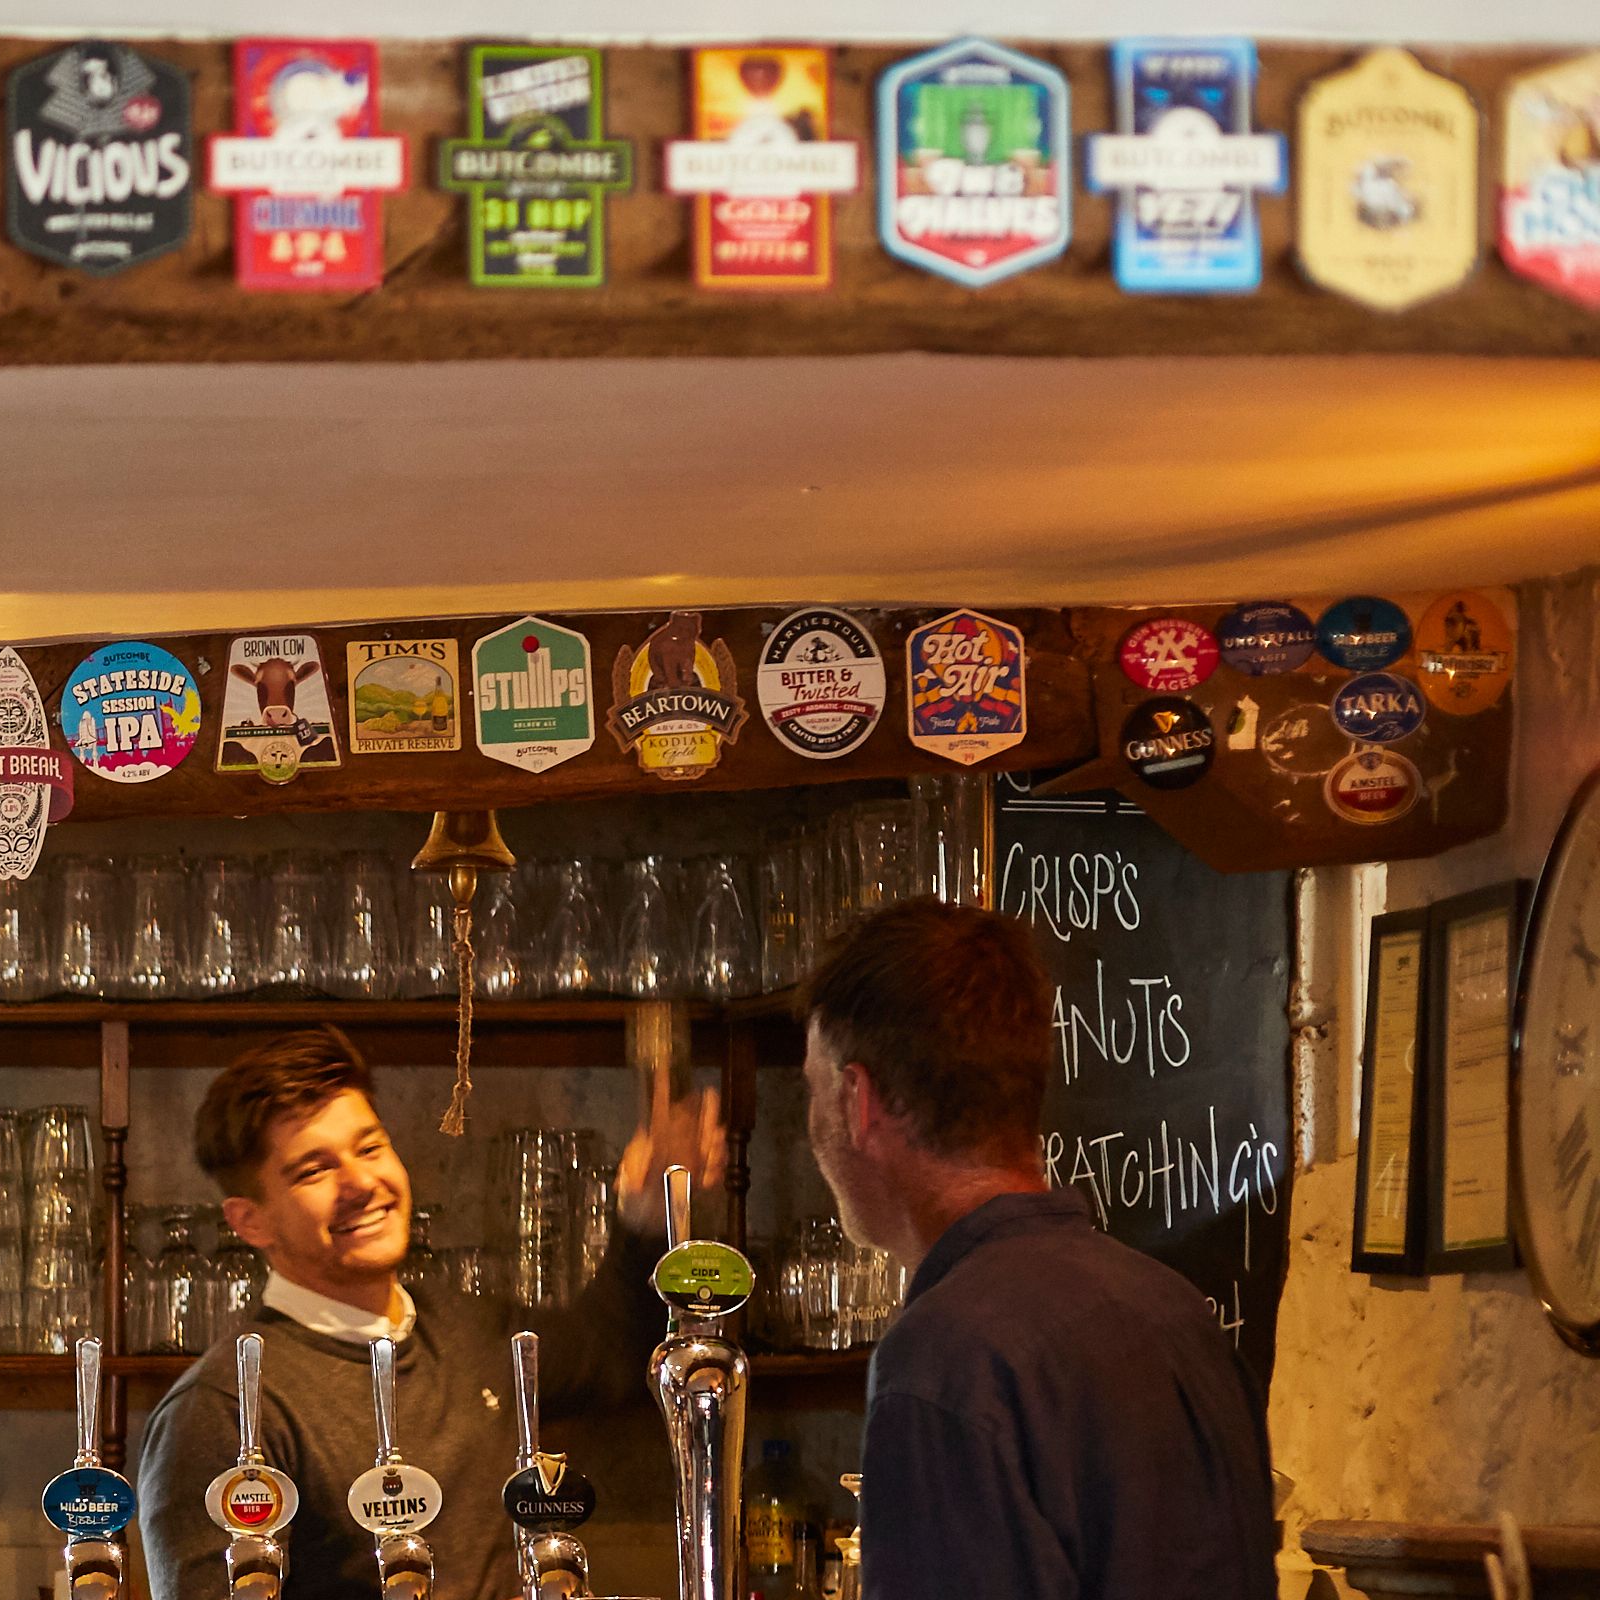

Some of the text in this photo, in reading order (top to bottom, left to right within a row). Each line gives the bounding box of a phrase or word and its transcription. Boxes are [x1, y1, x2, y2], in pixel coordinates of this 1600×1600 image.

[13, 128, 190, 206] VICIOUS
[243, 638, 305, 657] BROWN COW
[772, 617, 868, 661] HARVIESTOUN
[923, 630, 991, 664] Hot
[102, 653, 151, 666] BUTCOMBE
[359, 641, 447, 662] TIM'S
[1252, 653, 1288, 663] LAGER
[71, 670, 187, 705] STATESIDE
[480, 647, 586, 710] STUMPS
[780, 669, 853, 687] BITTER &
[939, 663, 1010, 699] Air
[1146, 674, 1200, 691] LAGER
[788, 682, 860, 701] Twisted
[102, 695, 155, 714] SESSION
[621, 694, 731, 729] BEARTOWN
[1343, 694, 1420, 713] TARKA
[104, 716, 164, 752] IPA
[647, 734, 709, 749] KODIAK
[357, 737, 455, 751] PRIVATE RESERVE
[516, 746, 559, 757] BUTCOMBE
[1126, 729, 1212, 761] GUINNESS
[10, 754, 64, 780] BREAK
[1349, 777, 1398, 788] AMSTEL
[1050, 959, 1192, 1086] ANUT'S
[1039, 1106, 1279, 1272] RATCHING'S
[691, 1269, 720, 1277] CIDER
[60, 1502, 118, 1512] WILD BEER
[234, 1493, 271, 1502] AMSTEL
[516, 1500, 585, 1514] GUINNESS
[243, 1505, 261, 1513] BIER
[362, 1497, 427, 1518] VELTINS
